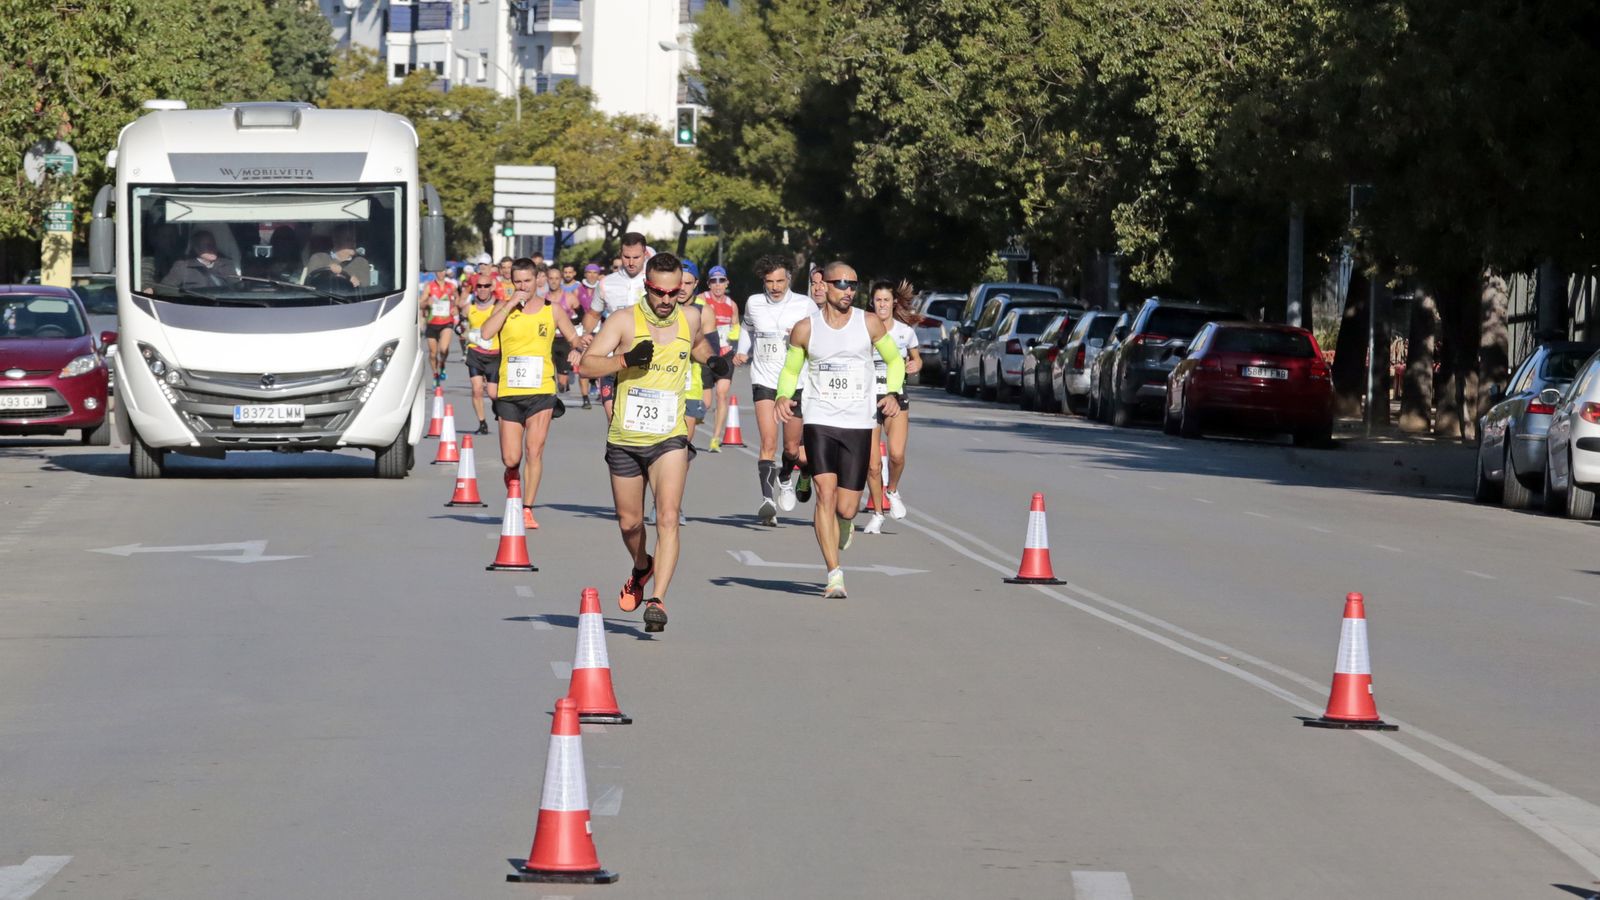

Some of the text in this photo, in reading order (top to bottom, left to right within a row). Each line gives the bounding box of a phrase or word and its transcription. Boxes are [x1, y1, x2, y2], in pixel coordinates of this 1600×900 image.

[242, 168, 313, 176] MOBILVETTA
[763, 343, 778, 353] 176
[516, 368, 527, 378] 62
[828, 377, 848, 390] 498
[23, 397, 43, 407] GJM
[242, 407, 302, 419] 8372 LMM
[636, 404, 659, 420] 733
